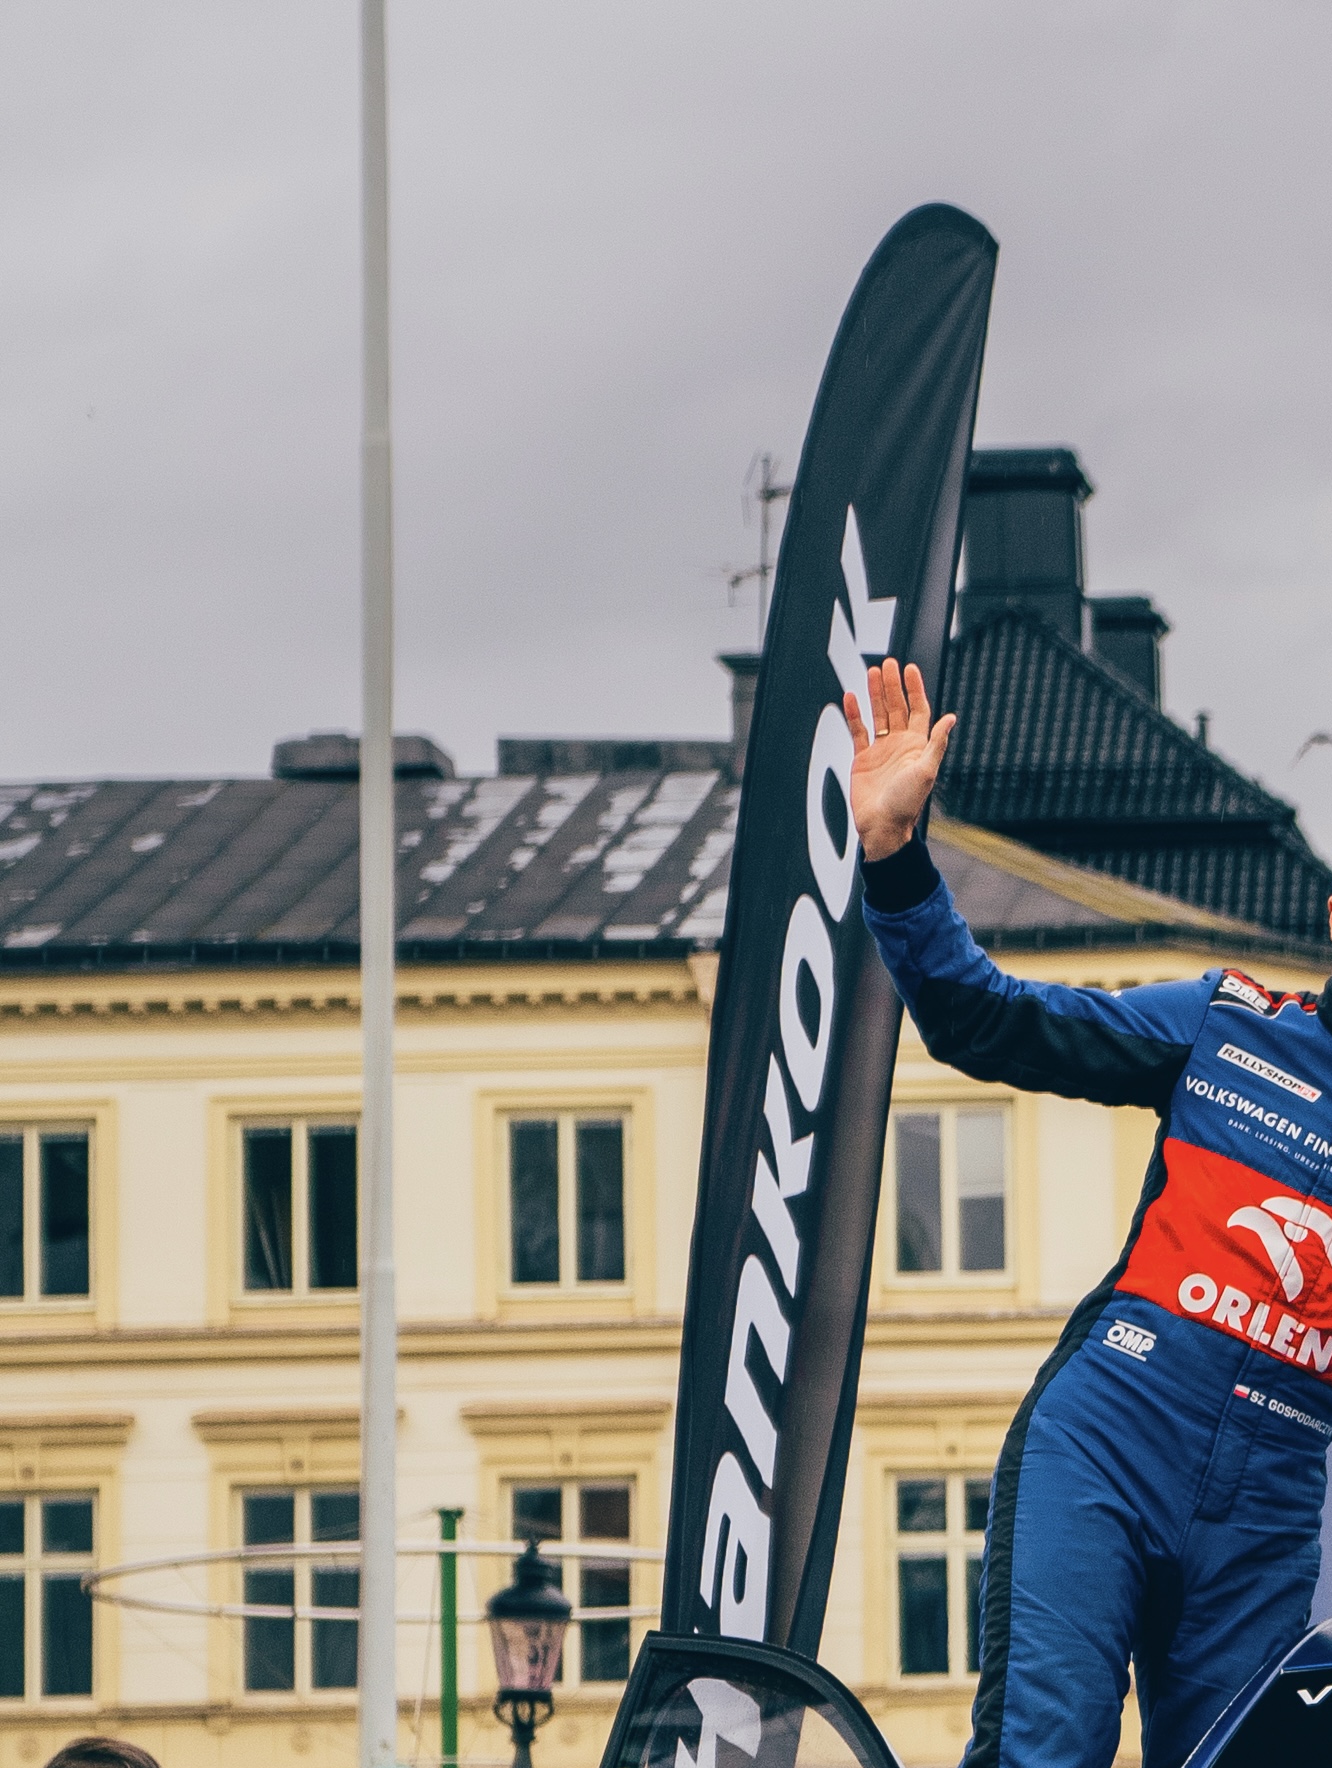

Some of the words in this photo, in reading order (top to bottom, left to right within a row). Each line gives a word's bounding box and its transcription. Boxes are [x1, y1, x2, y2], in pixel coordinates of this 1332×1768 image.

[1186, 1076, 1303, 1140] VOLKSWAGEN
[1106, 1324, 1155, 1355] OMP
[1250, 1391, 1265, 1407] SZ
